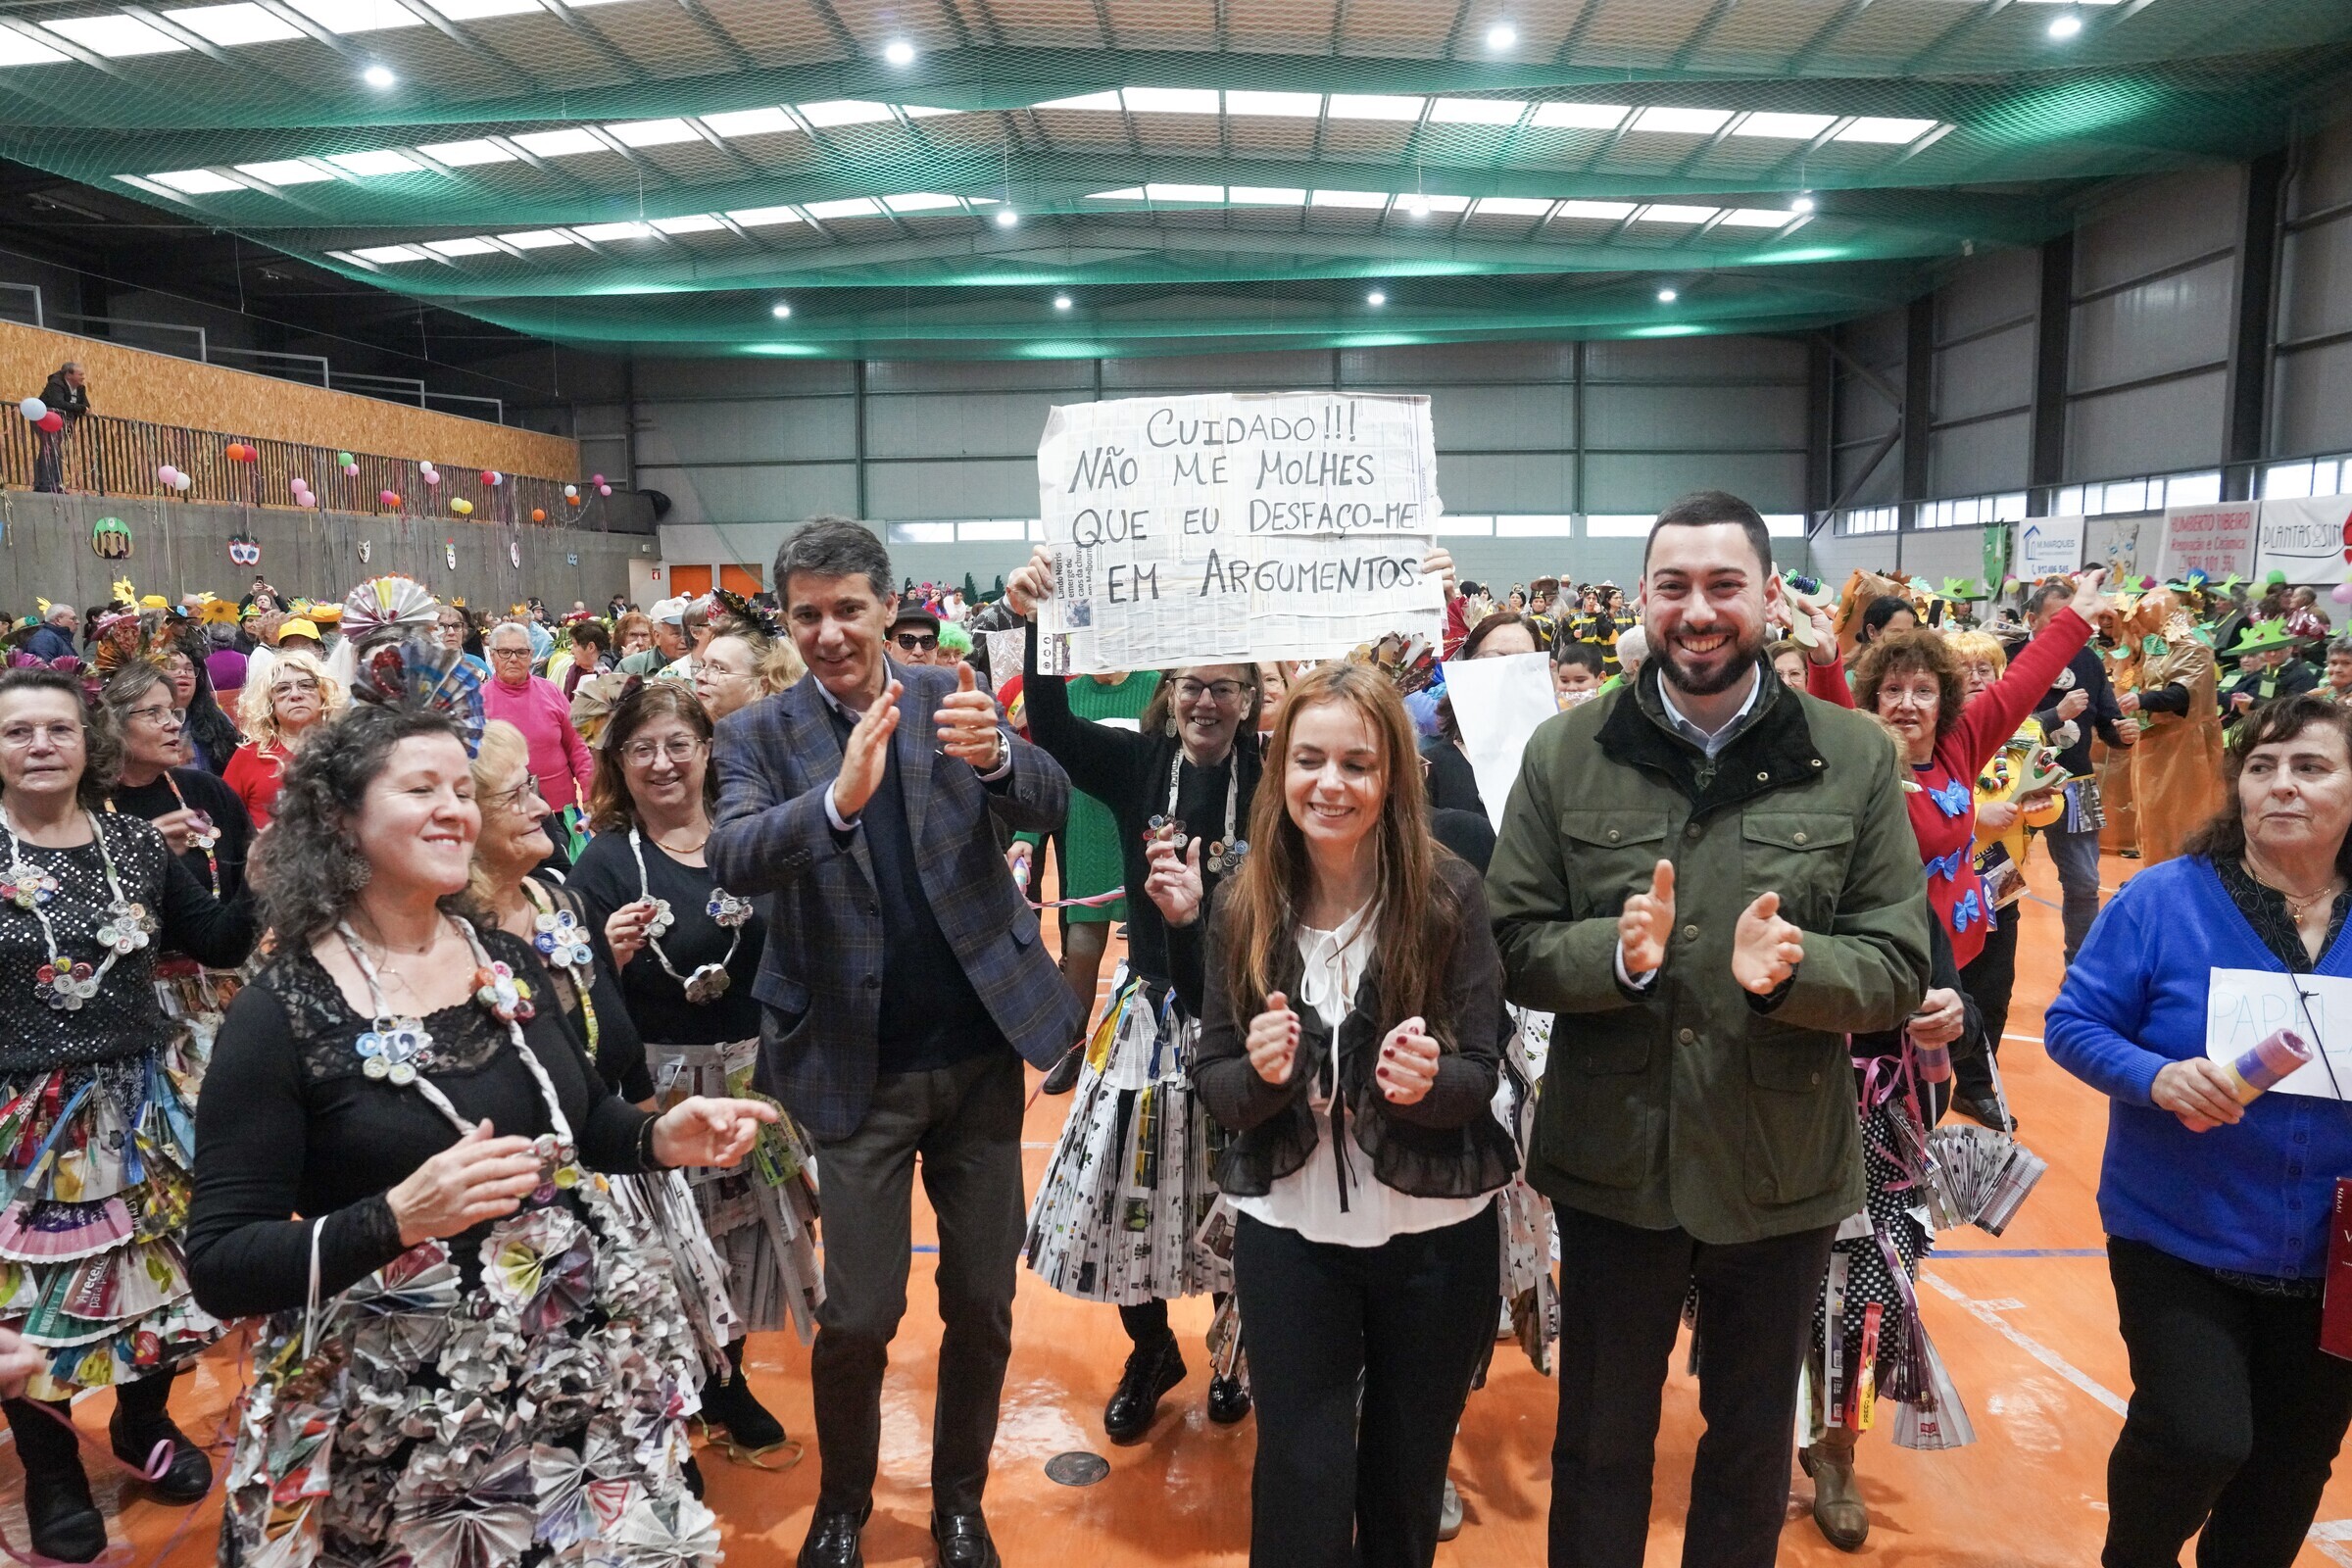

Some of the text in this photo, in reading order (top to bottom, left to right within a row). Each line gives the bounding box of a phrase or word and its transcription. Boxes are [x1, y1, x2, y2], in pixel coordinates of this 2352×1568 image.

[1067, 445, 1374, 493] NÃO ME MOLHES
[1072, 508, 1151, 549] QUE
[1184, 507, 1221, 536] EU
[1054, 552, 1065, 600] Lando Norris
[1065, 559, 1075, 599] emerge do
[1075, 568, 1084, 578] da
[1107, 547, 1424, 605] EM ARGUMENTOS.
[2212, 991, 2352, 1054] PAPEL
